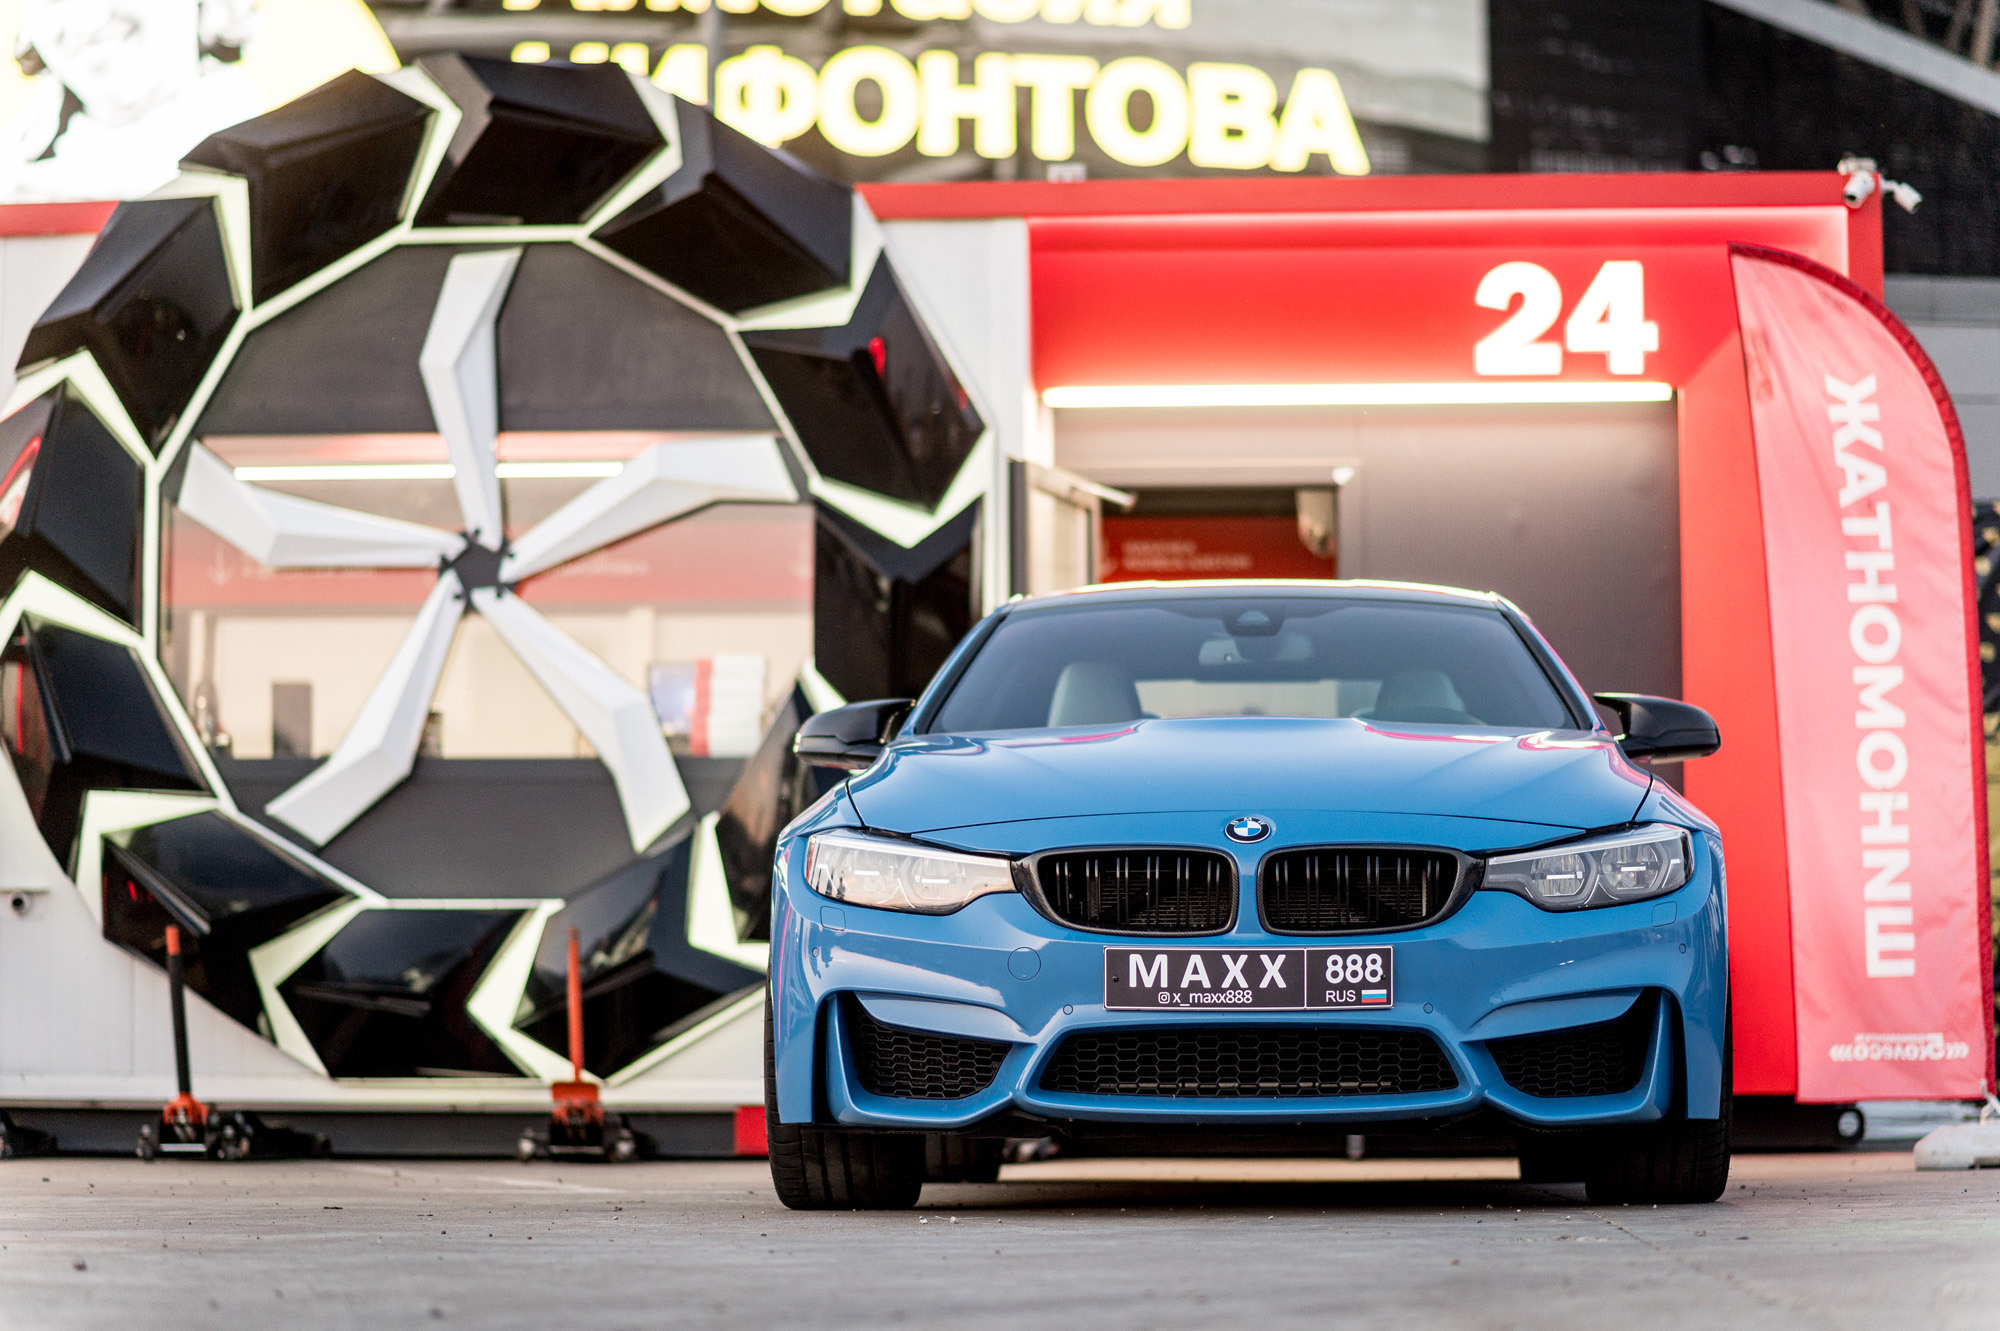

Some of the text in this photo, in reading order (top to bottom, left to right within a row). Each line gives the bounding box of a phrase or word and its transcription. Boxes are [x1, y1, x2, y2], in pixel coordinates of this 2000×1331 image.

[511, 41, 1371, 176] ФОНТОВА
[1474, 260, 1660, 376] 24
[1129, 953, 1383, 989] MAXX 888
[1172, 989, 1253, 1007] x_maxx888
[1325, 989, 1356, 1003] RUS
